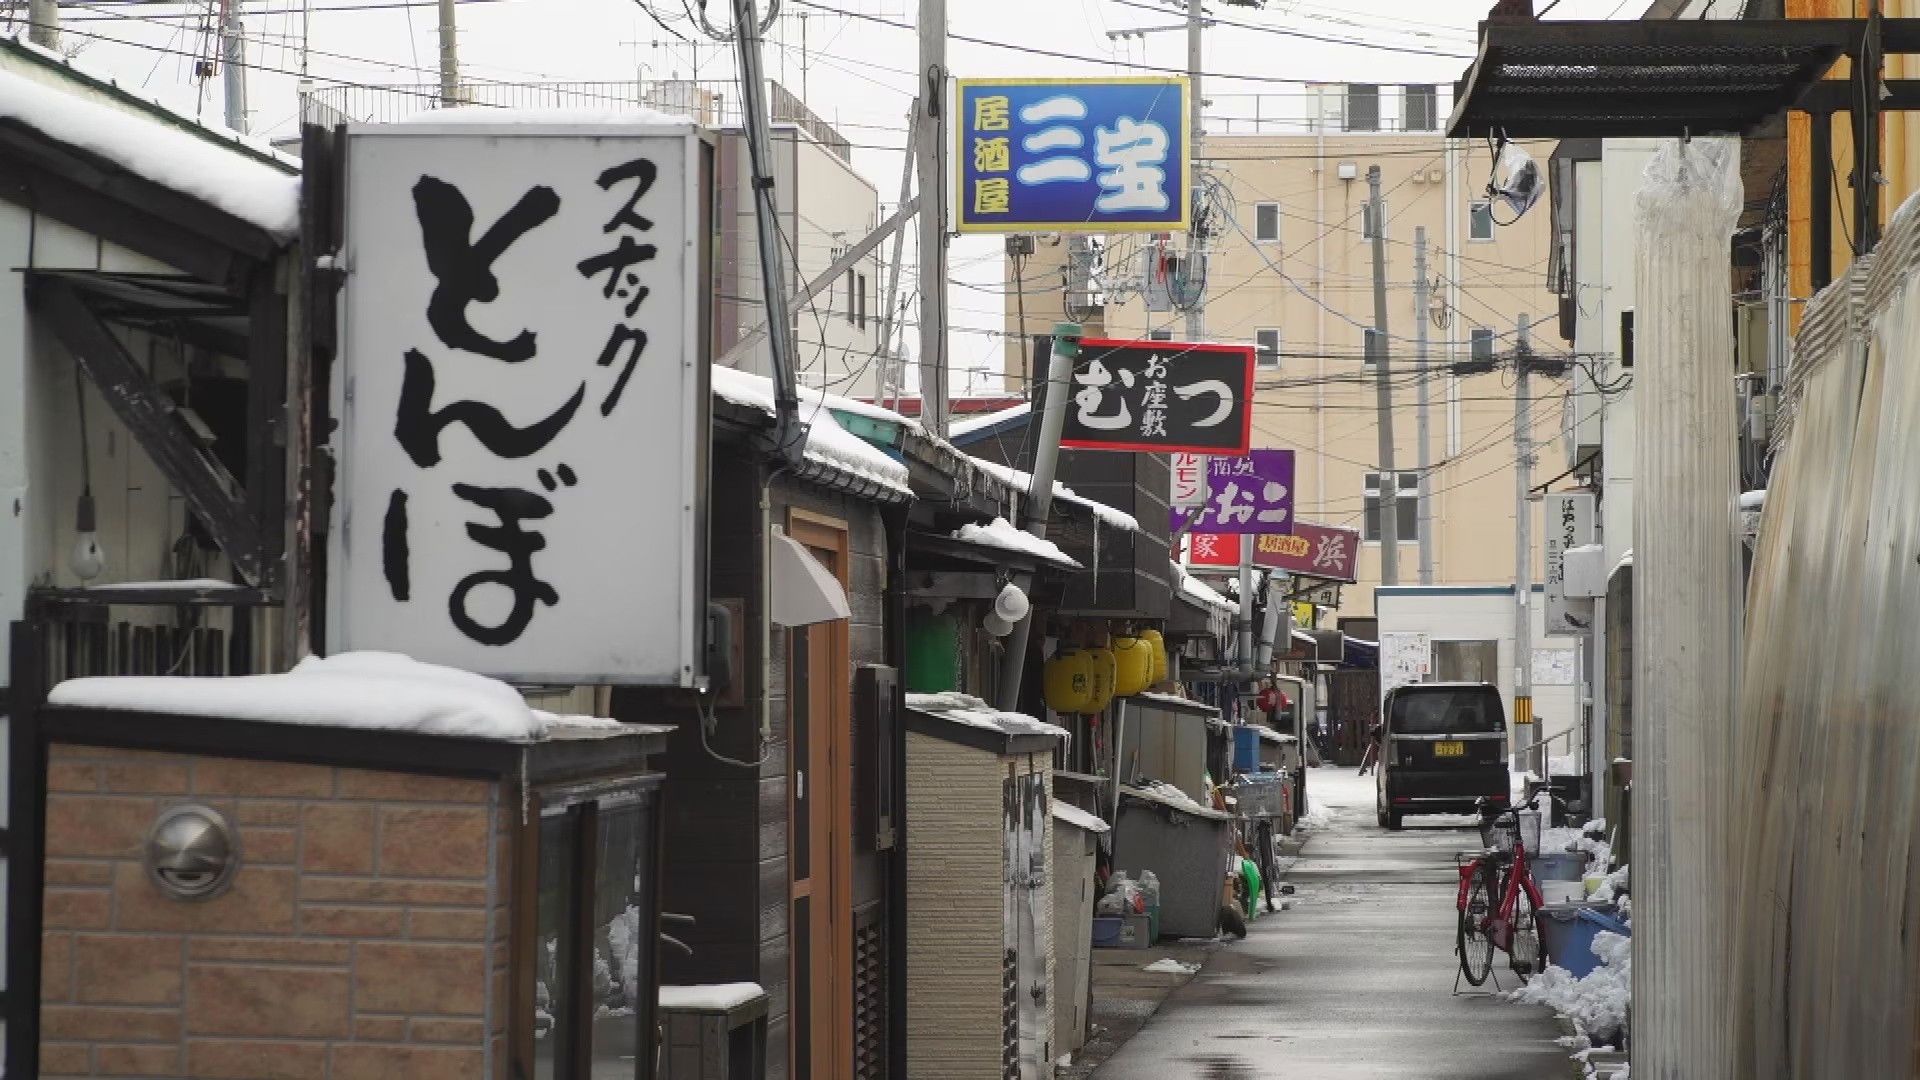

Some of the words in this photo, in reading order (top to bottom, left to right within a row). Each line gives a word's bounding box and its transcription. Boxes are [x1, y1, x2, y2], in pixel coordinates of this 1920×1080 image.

[974, 96, 1009, 214] 居酒屋
[1017, 97, 1169, 211] 三宝
[577, 158, 657, 417] スナック
[383, 173, 586, 647] とんぼ
[1140, 354, 1168, 437] お座敷
